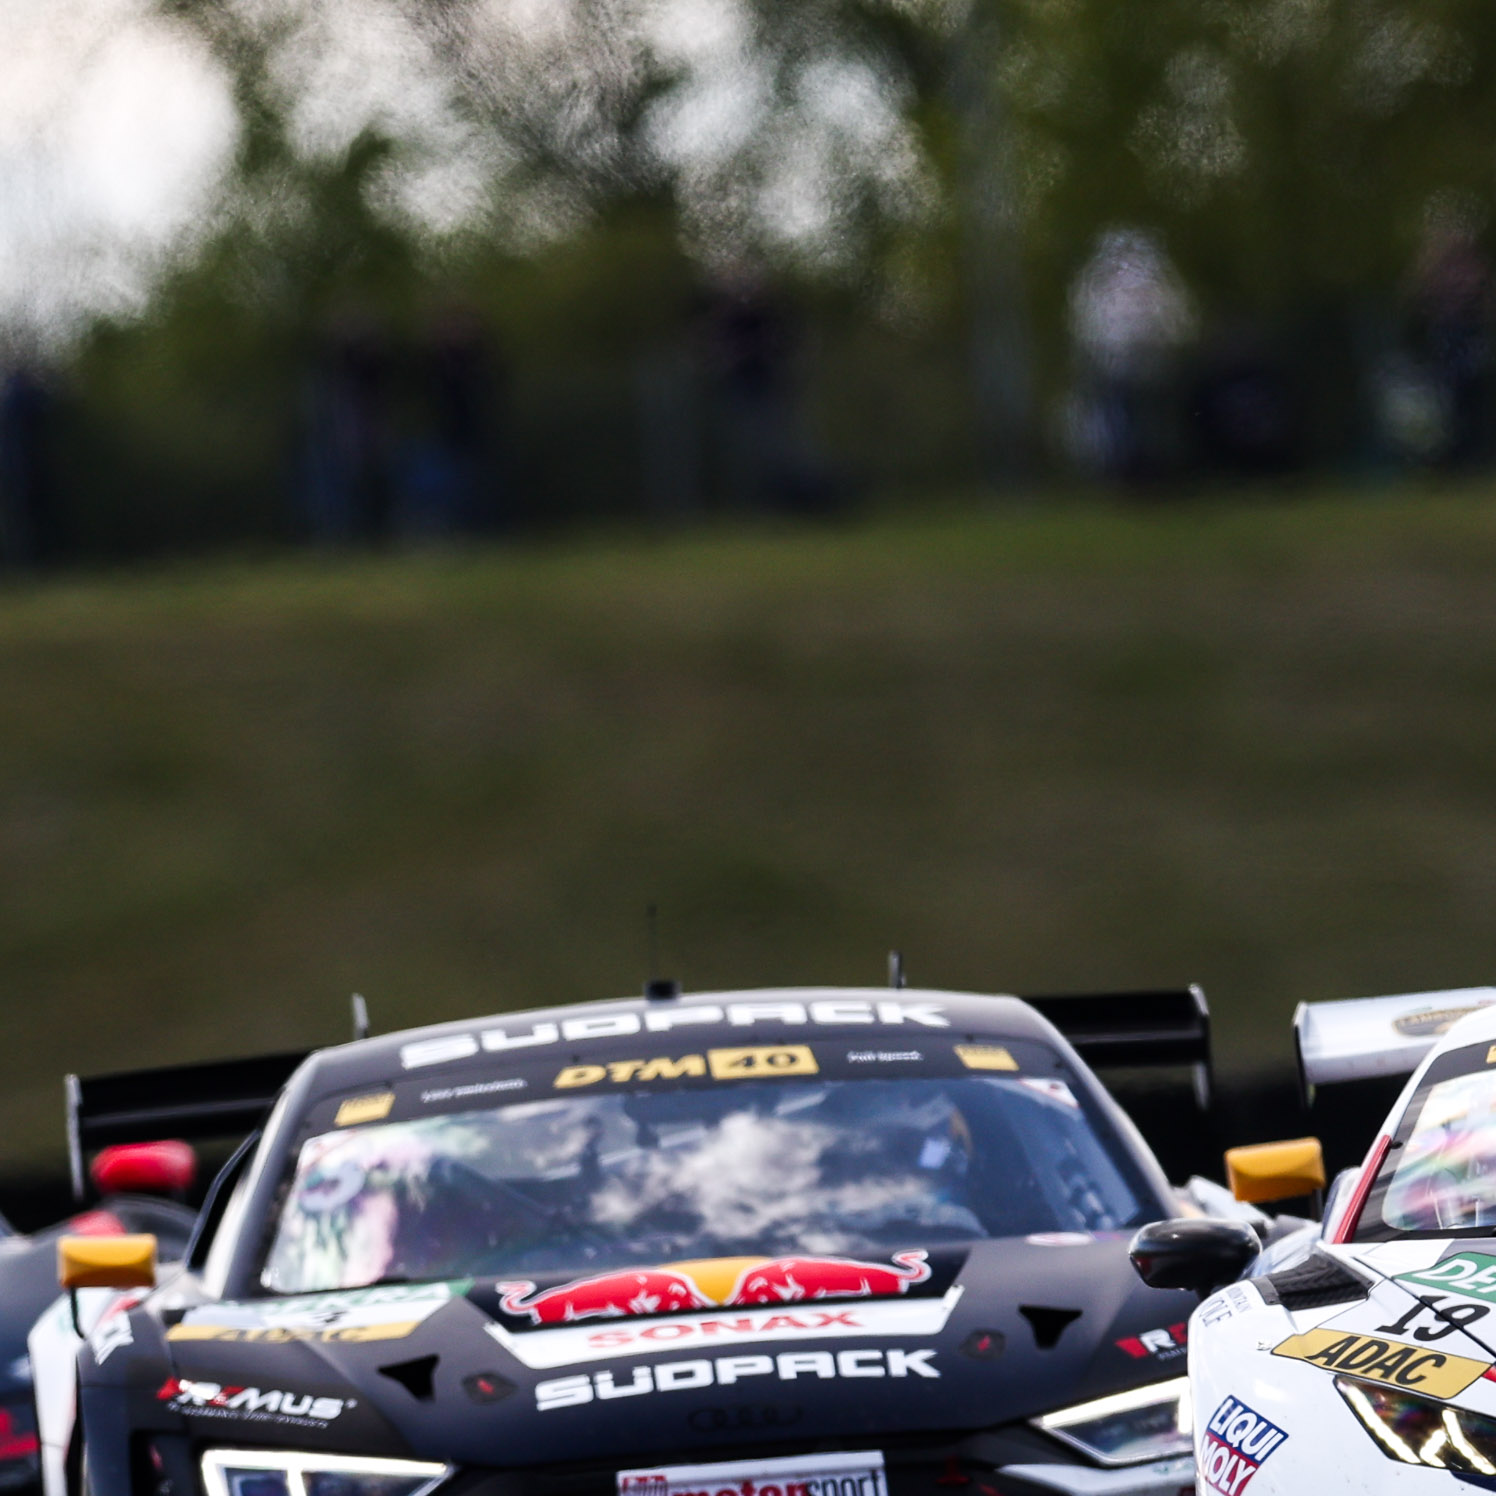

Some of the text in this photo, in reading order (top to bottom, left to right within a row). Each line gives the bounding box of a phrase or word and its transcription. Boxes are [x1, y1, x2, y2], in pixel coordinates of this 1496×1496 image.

[552, 1051, 799, 1089] DTM 40
[588, 1310, 863, 1349] SONAX
[1374, 1294, 1491, 1342] 19
[1305, 1335, 1447, 1386] ADAC
[1209, 1398, 1285, 1462] LIQUI
